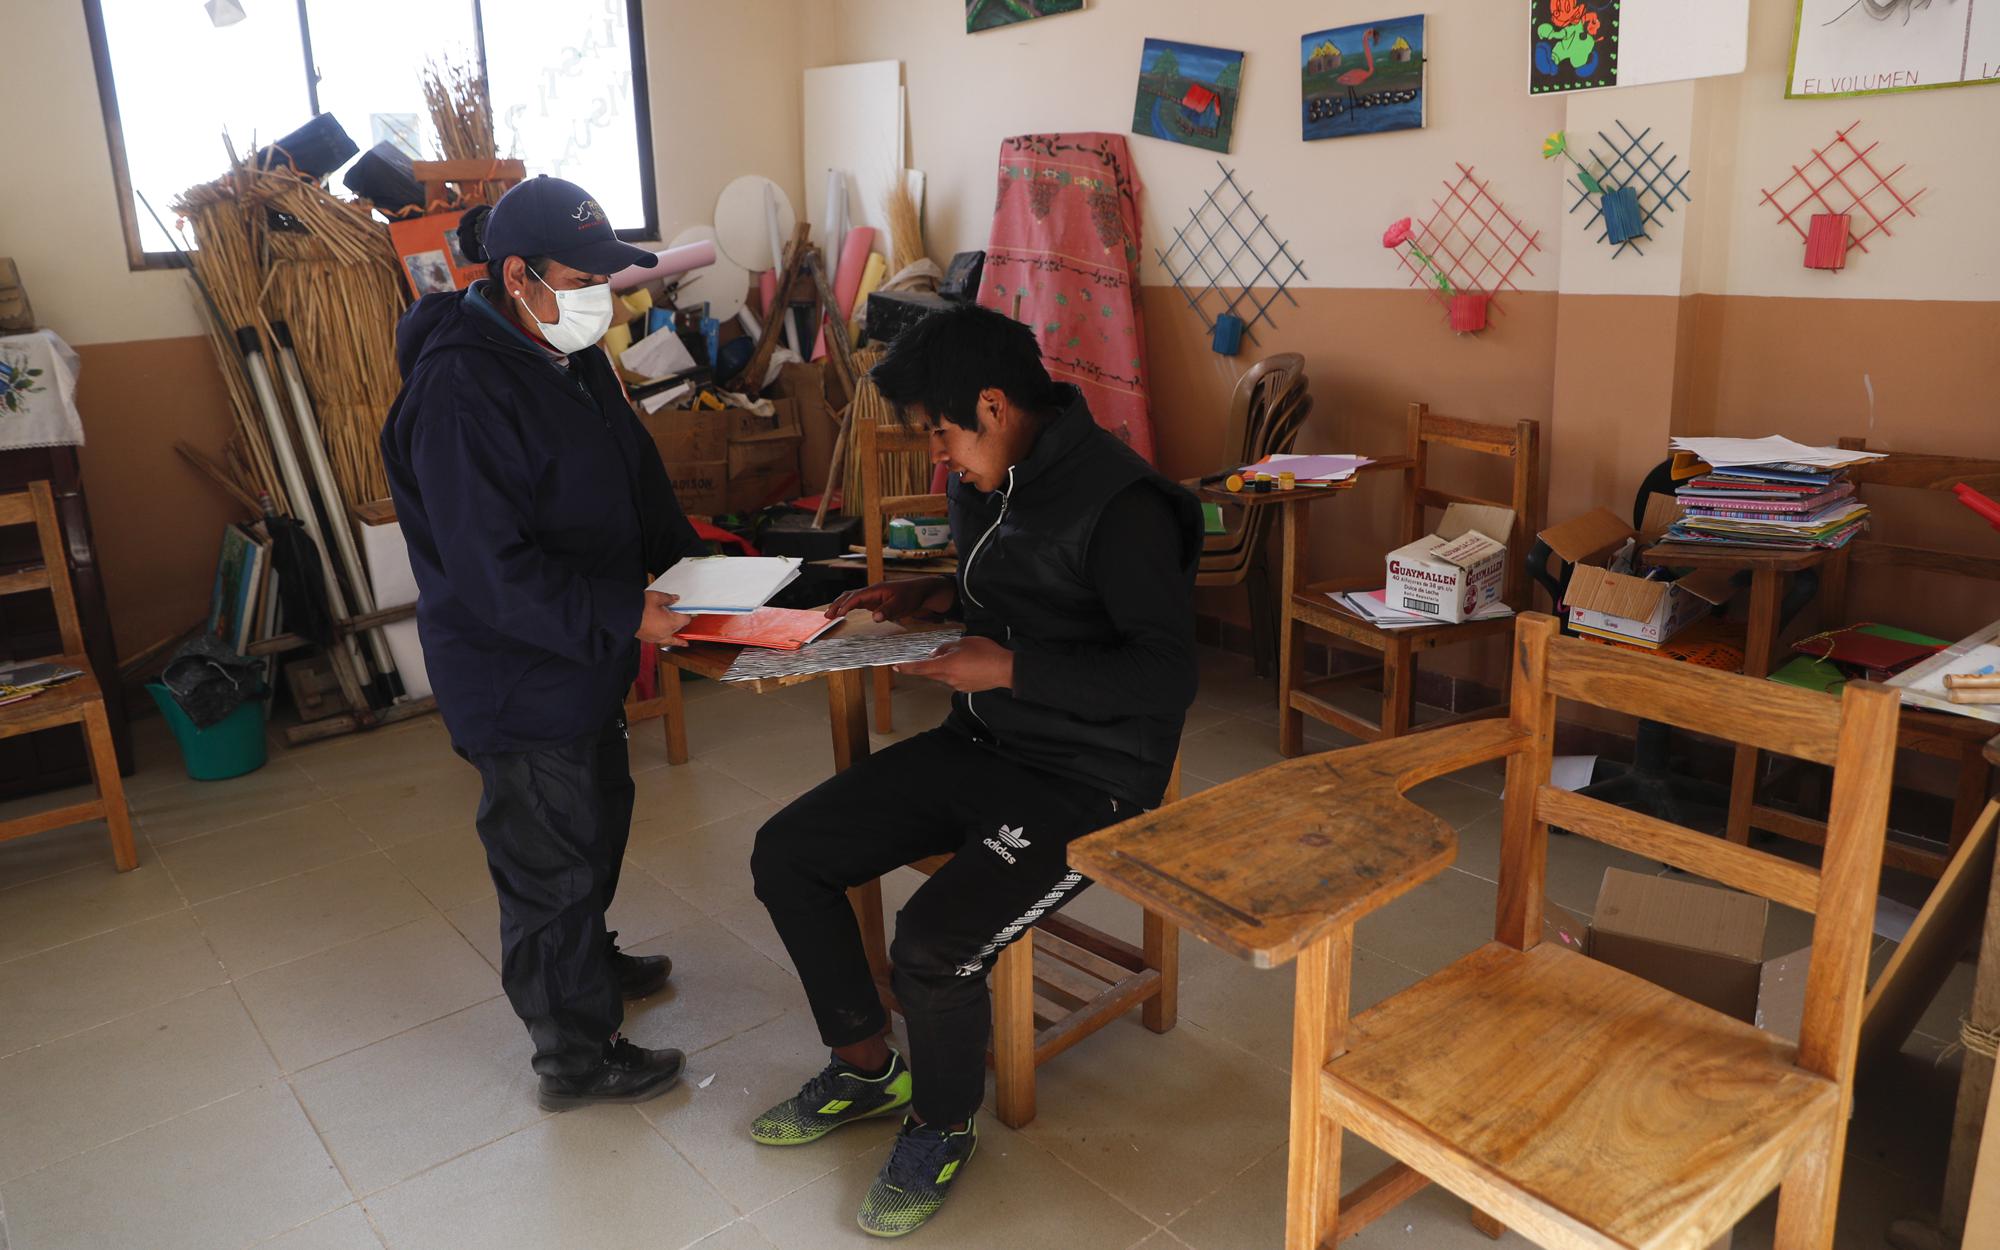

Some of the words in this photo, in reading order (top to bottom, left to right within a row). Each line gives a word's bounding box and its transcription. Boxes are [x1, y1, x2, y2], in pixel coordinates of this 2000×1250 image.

[1803, 78, 1825, 94] EL
[1830, 70, 1920, 93] VOLUMEN
[1389, 560, 1456, 586] GUAYMALLEN
[1465, 560, 1503, 587] GUAYMALLEN
[1425, 588, 1439, 596] Leche
[982, 837, 1017, 865] adidas
